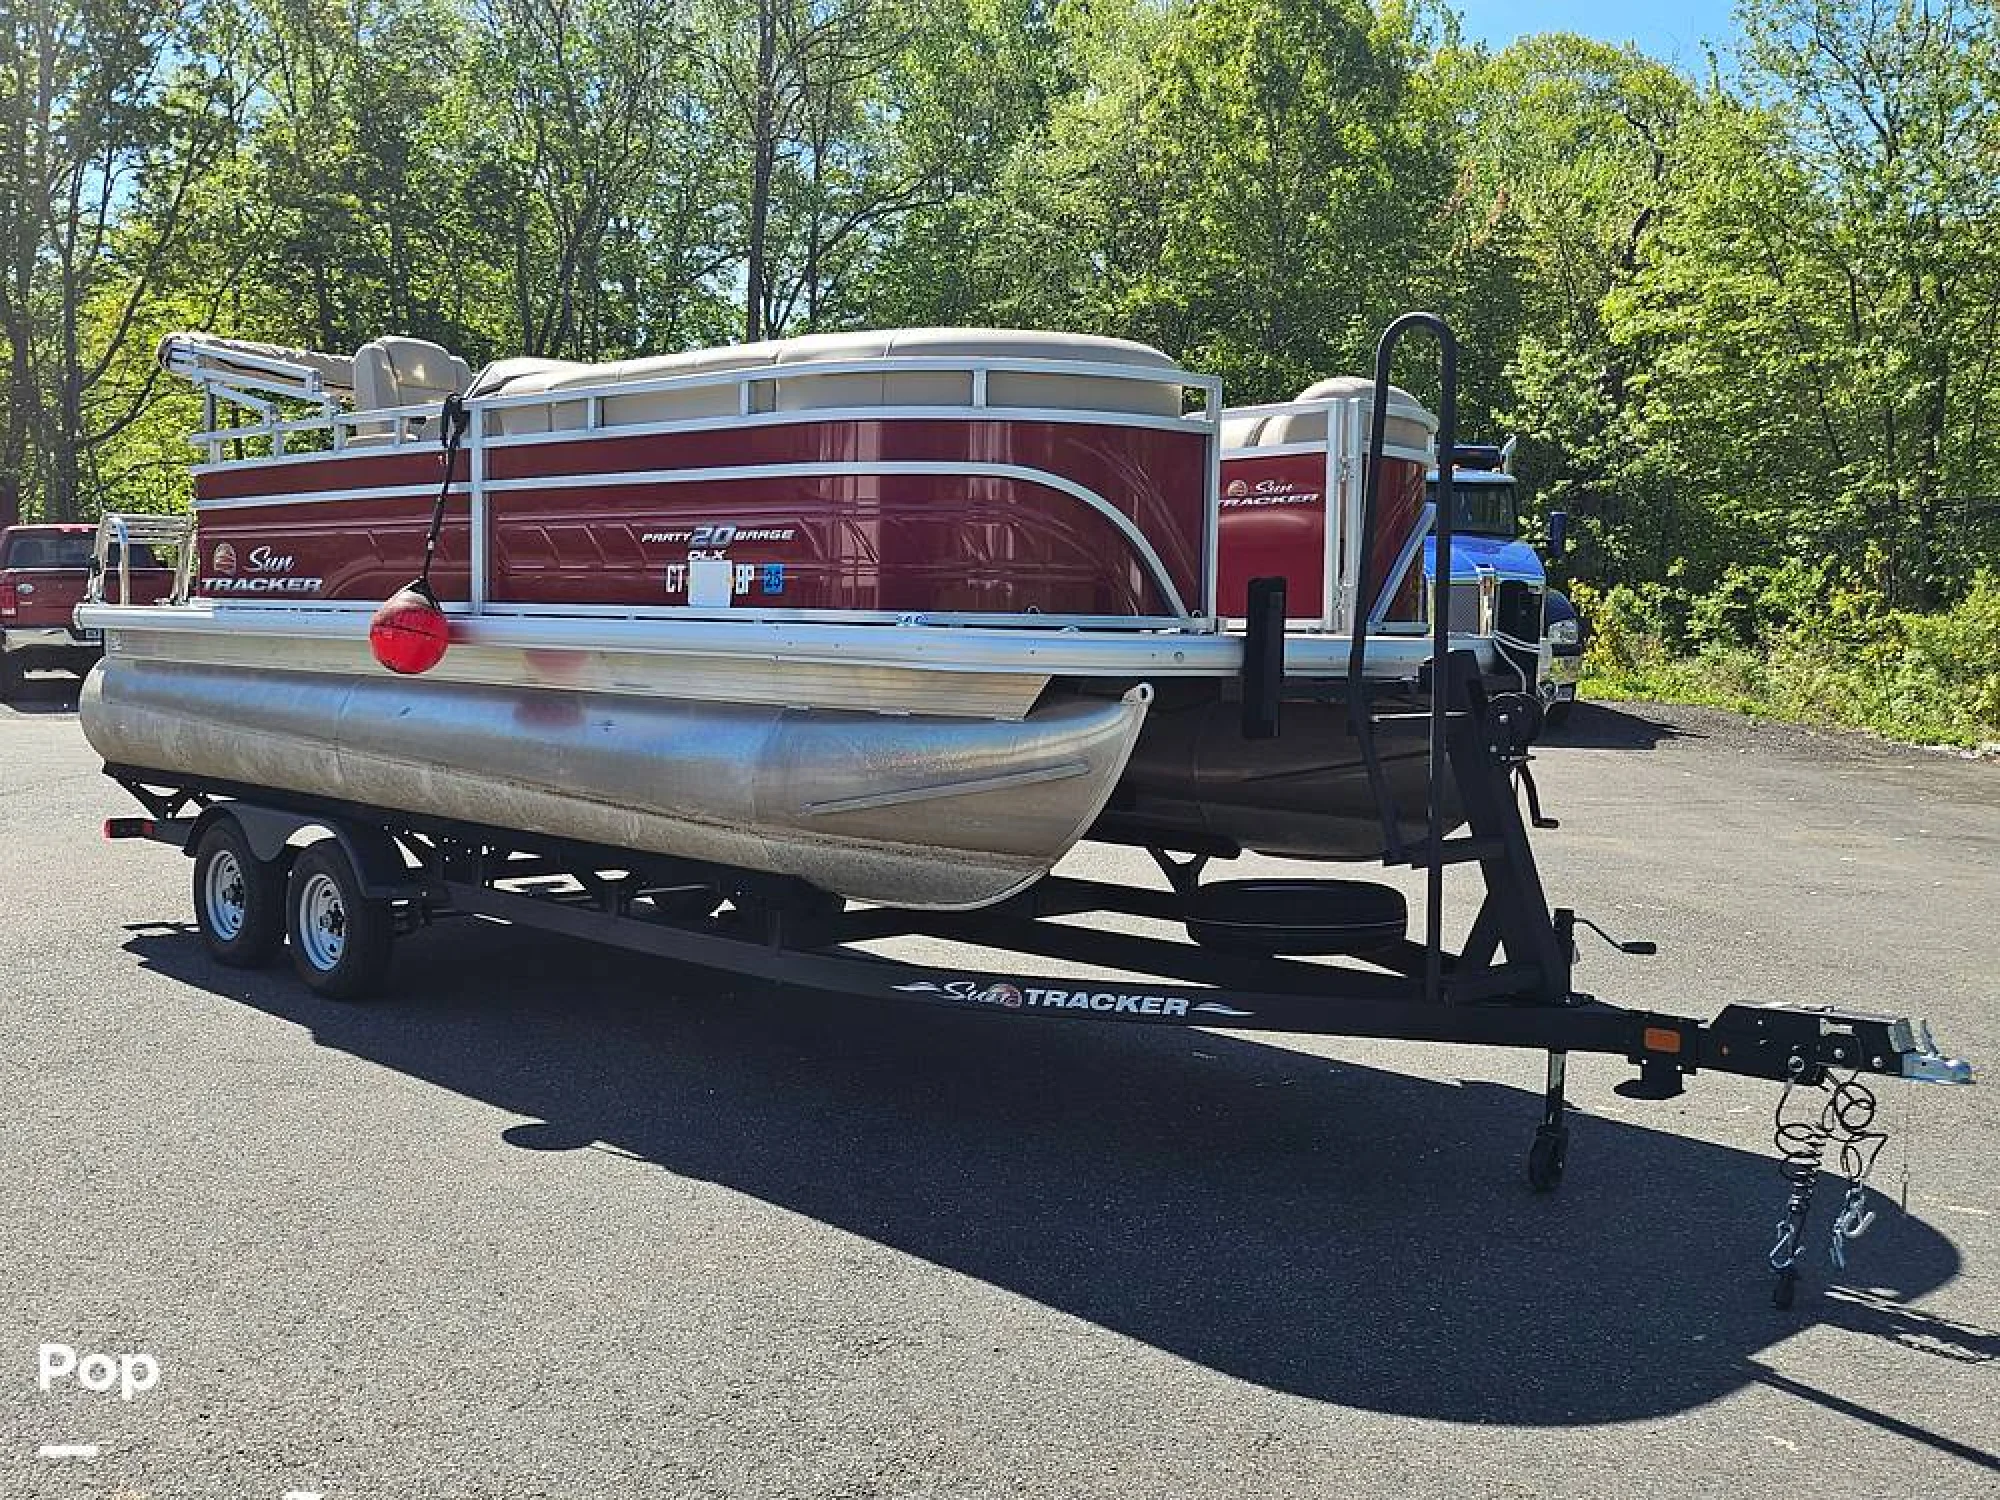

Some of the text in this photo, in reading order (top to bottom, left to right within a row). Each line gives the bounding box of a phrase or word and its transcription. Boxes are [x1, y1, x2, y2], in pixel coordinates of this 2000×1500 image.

[1248, 480, 1294, 495] Sun
[641, 524, 796, 548] PARTY 20 BARGE
[241, 545, 296, 573] Sun
[201, 577, 323, 592] TRACKER
[665, 564, 686, 593] CT
[735, 564, 756, 595] BP
[1024, 988, 1190, 1017] TRACKER
